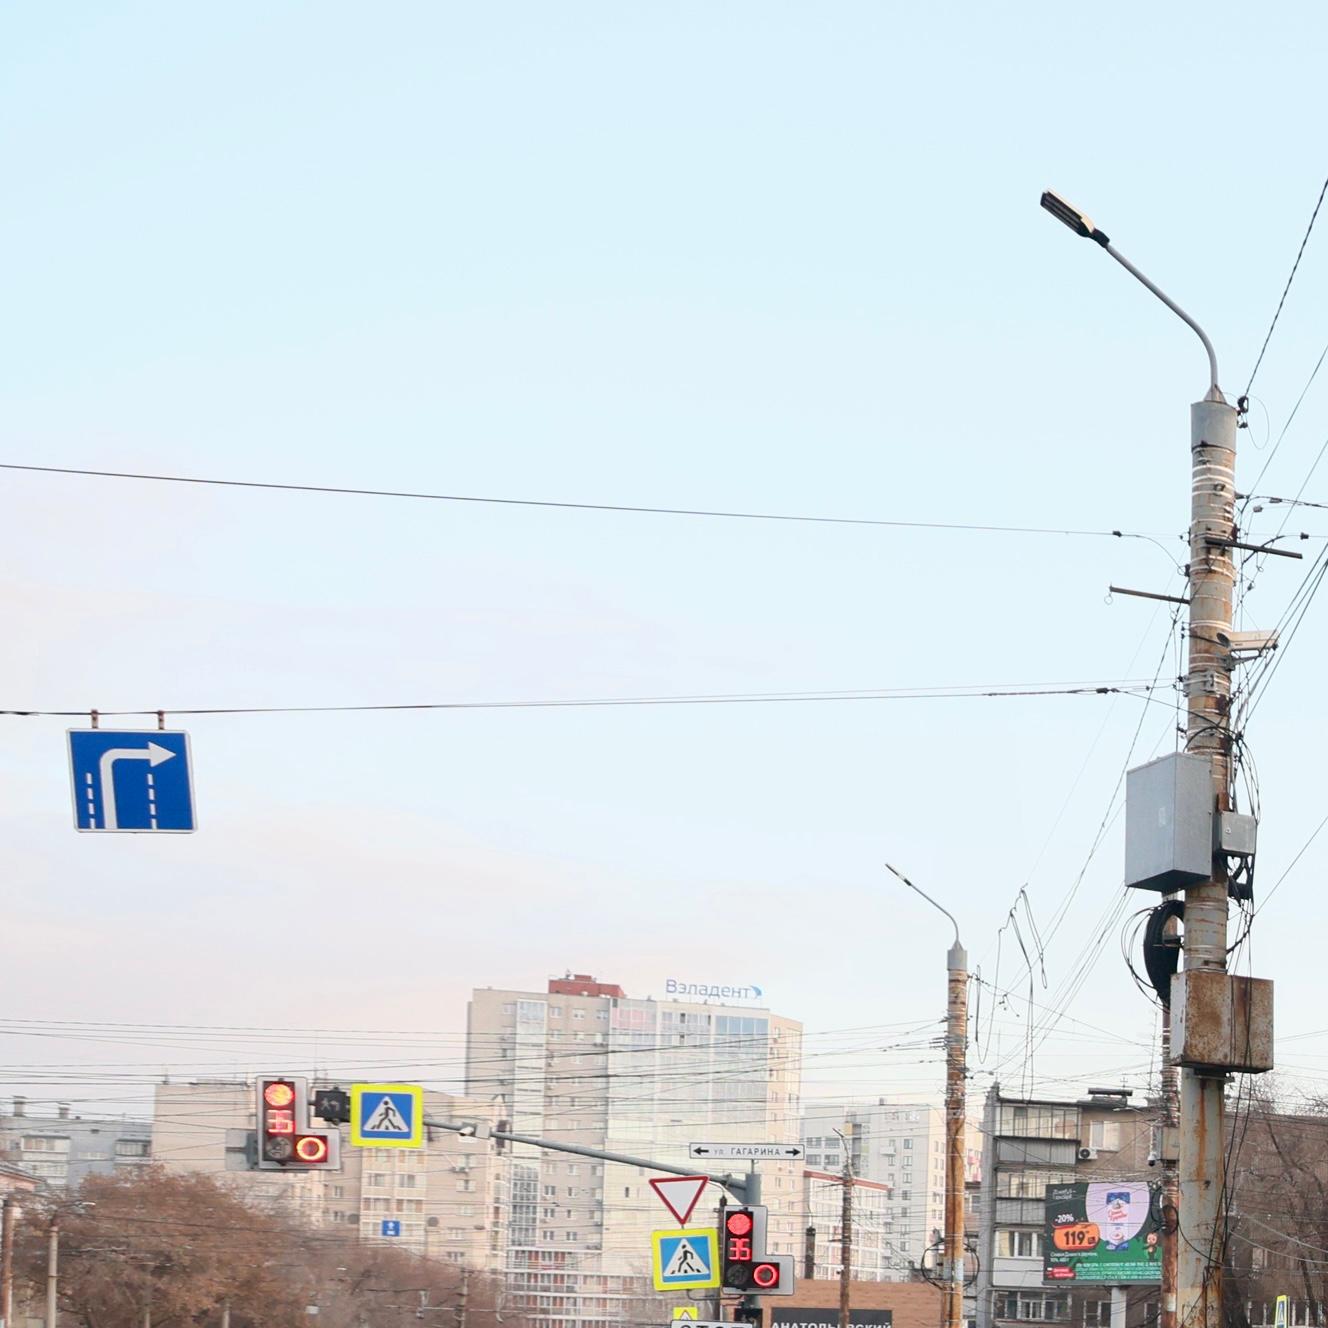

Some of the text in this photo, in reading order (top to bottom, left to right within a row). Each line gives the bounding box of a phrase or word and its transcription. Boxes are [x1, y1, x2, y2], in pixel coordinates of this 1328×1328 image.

[666, 978, 751, 999] Вэладент
[730, 1147, 781, 1156] ГАГАРИНА
[1063, 1231, 1086, 1246] 119
